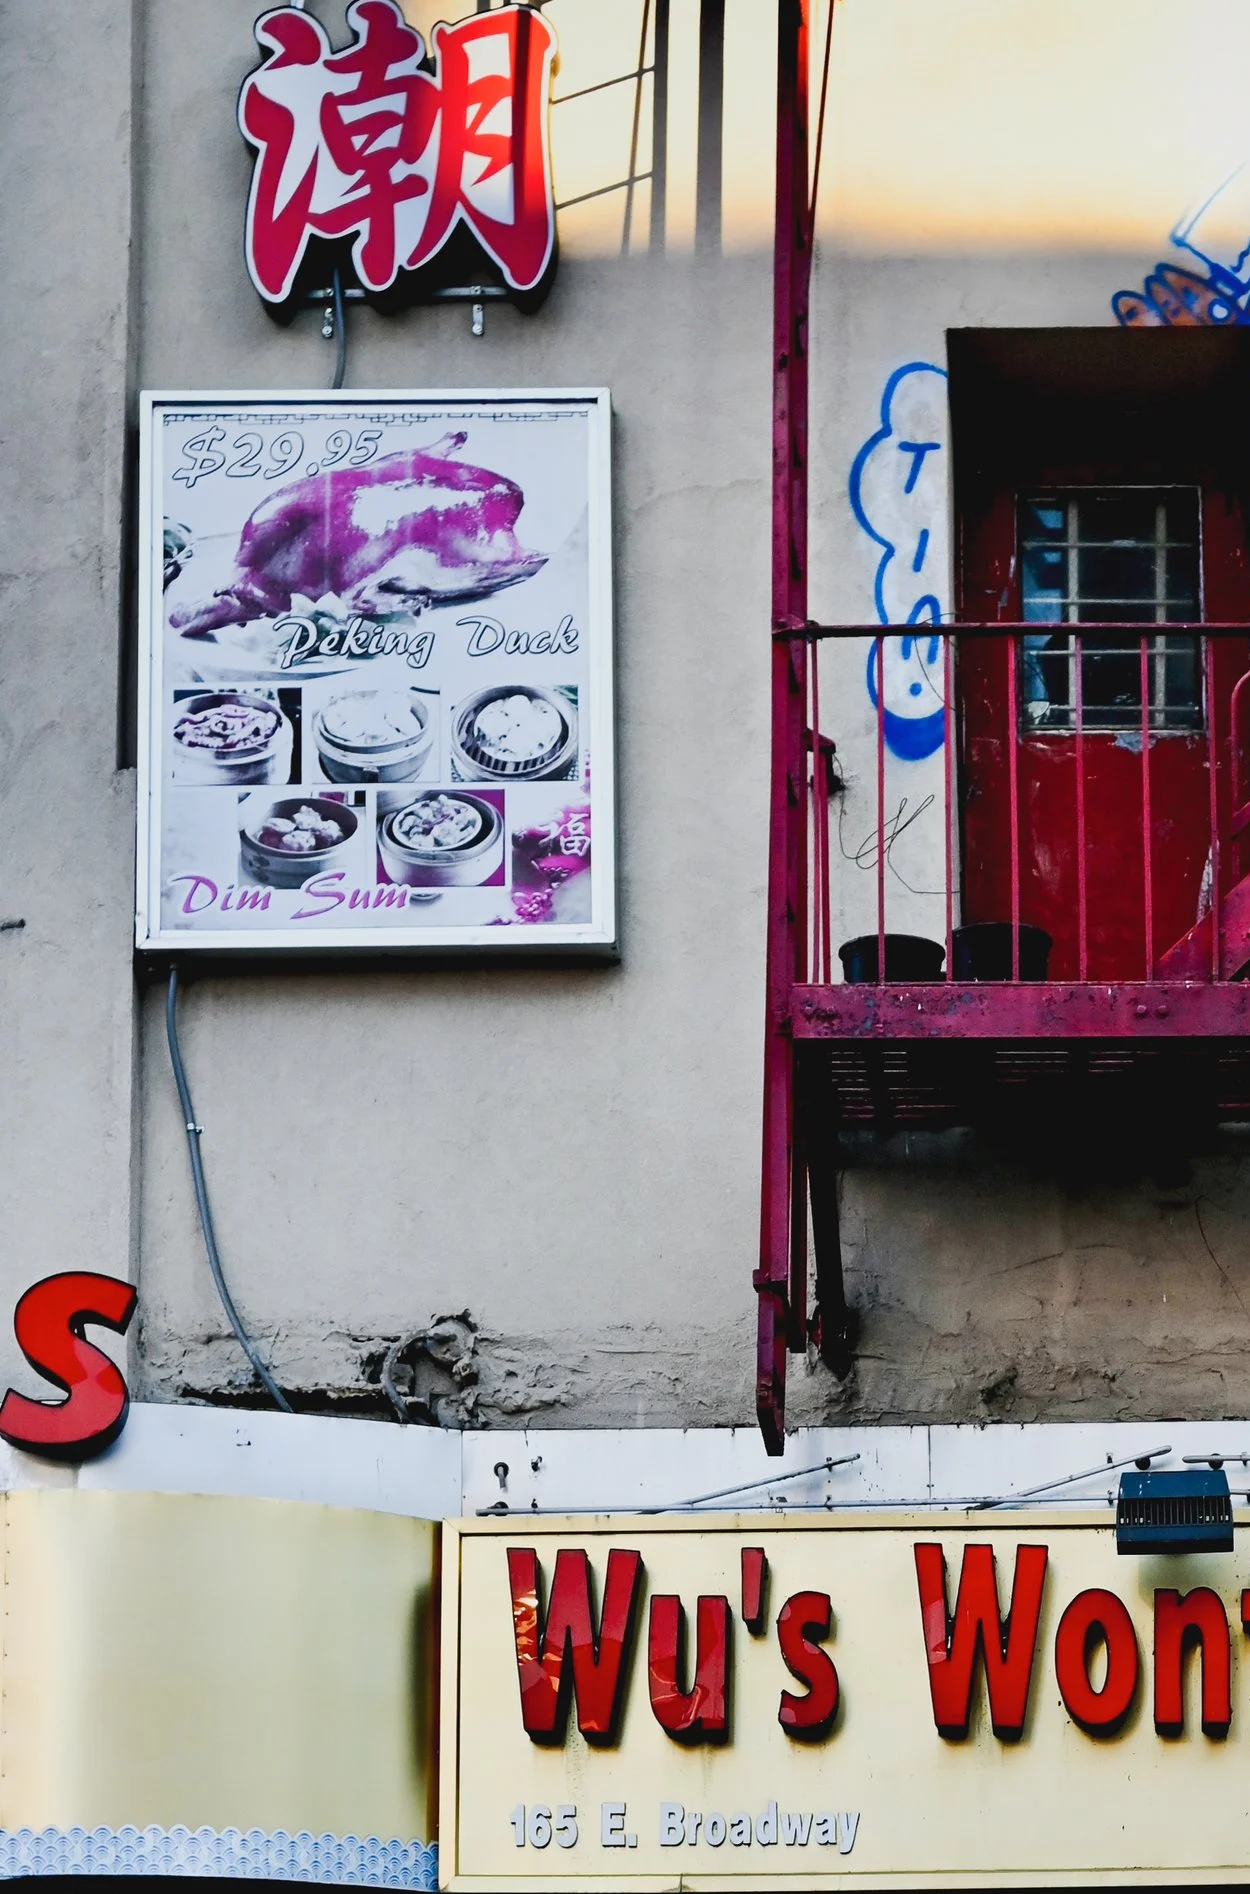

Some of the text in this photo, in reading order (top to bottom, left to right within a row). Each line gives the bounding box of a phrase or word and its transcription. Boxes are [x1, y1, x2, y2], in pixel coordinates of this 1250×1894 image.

[238, 1, 558, 312] 潮
[173, 425, 383, 487] $29.95
[273, 615, 579, 670] Peking Duck
[168, 872, 410, 920] Dim Sum
[506, 1546, 841, 1743] Wu's
[510, 1801, 861, 1855] 165 E. Broadway
